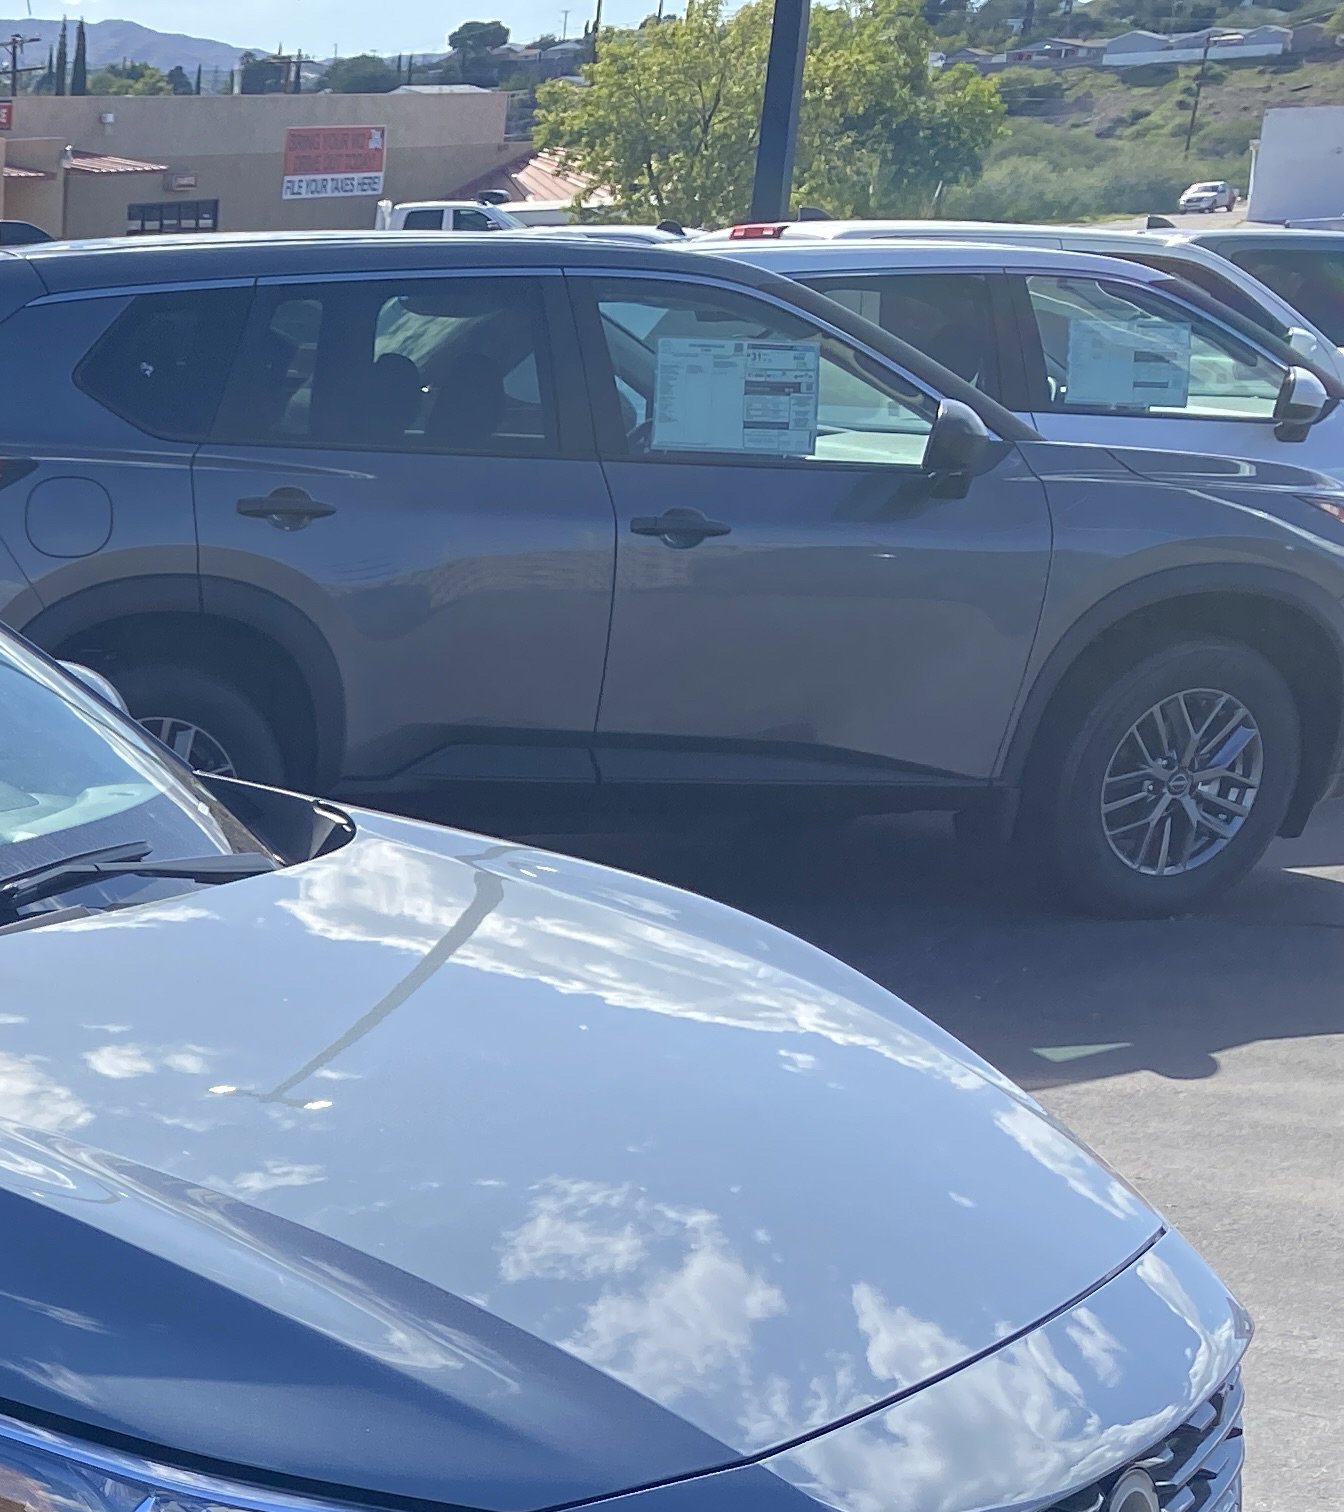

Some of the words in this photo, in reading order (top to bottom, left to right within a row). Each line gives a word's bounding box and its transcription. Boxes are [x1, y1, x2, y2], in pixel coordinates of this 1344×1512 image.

[285, 179, 303, 196] FILE
[306, 178, 328, 195] YOUR
[330, 177, 354, 193] TAXES
